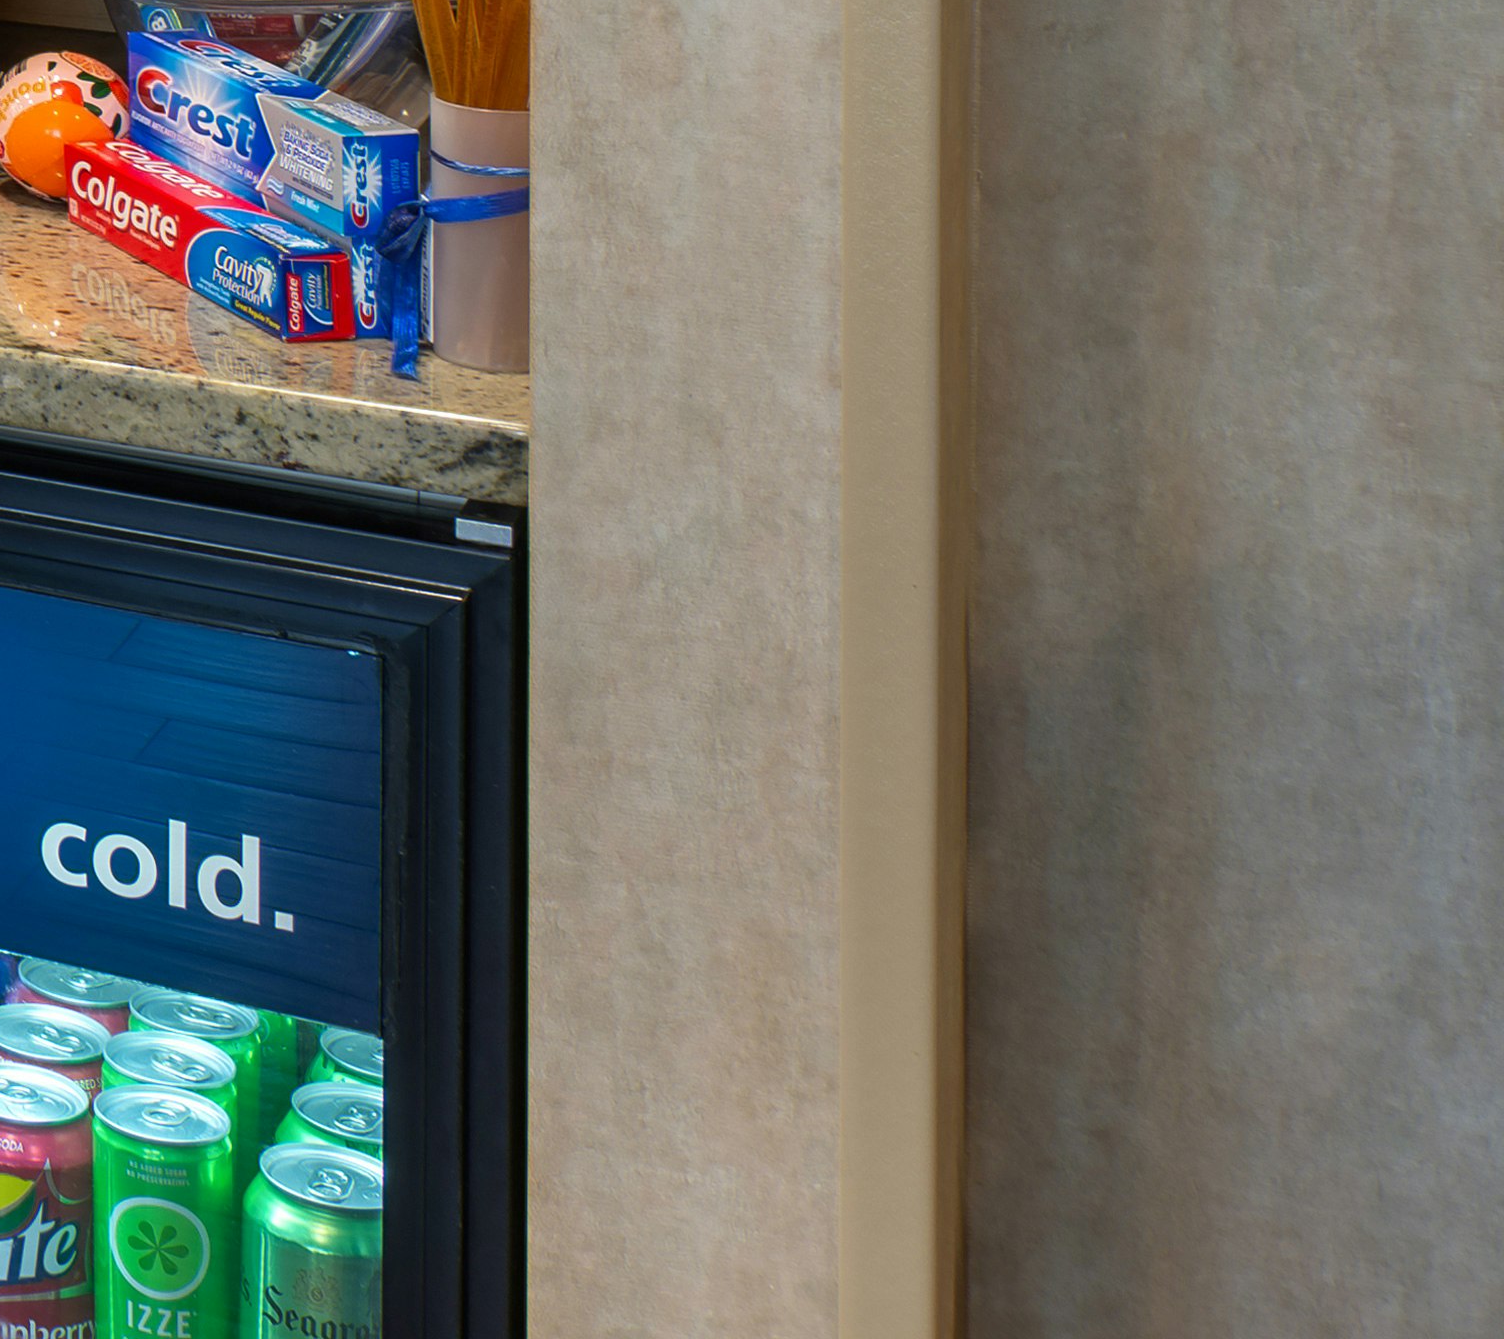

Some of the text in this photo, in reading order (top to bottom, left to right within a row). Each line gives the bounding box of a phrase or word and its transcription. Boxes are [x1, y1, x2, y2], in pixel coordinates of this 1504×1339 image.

[137, 67, 257, 161] Crest
[104, 140, 226, 201] Colgate
[71, 159, 178, 249] Colgate
[212, 268, 262, 307] Protection
[214, 245, 264, 291] Cavity
[289, 276, 303, 332] Colgate
[40, 817, 295, 935] cold.
[126, 1298, 192, 1339] IZZE
